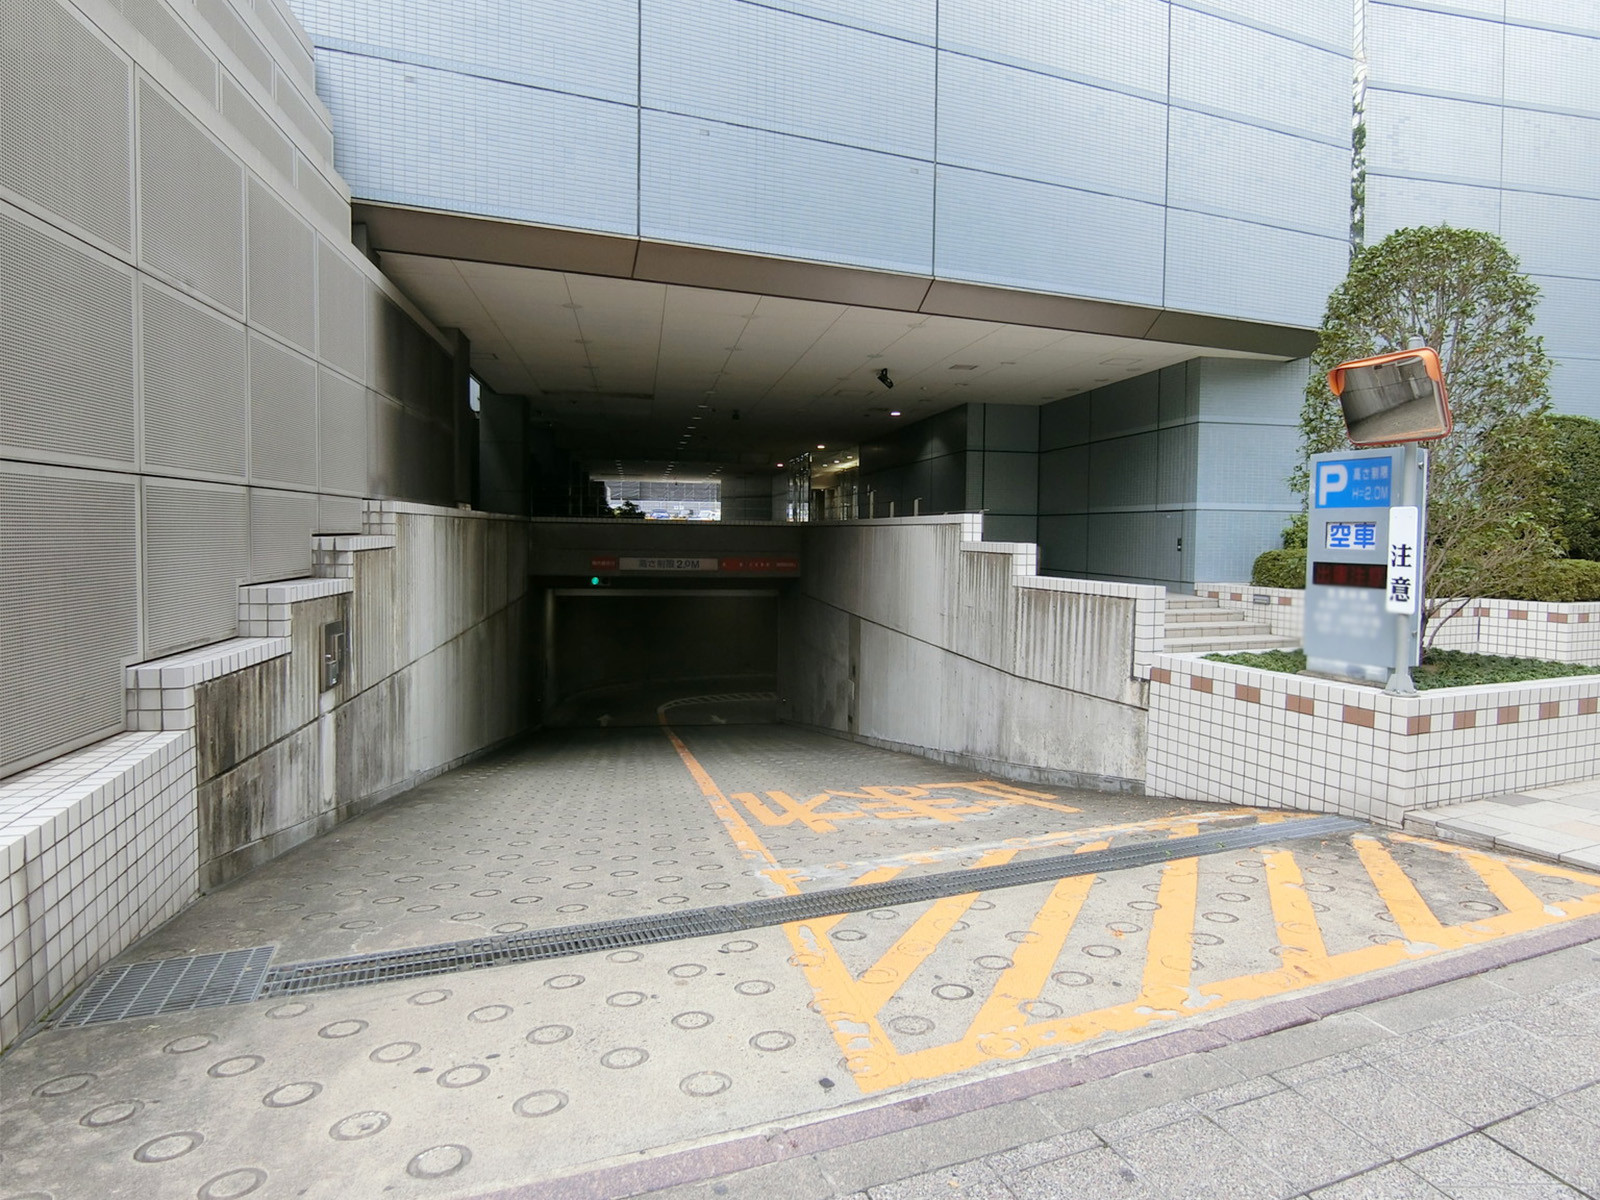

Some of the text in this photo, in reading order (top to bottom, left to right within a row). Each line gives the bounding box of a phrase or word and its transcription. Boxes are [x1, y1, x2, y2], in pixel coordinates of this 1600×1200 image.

[1319, 464, 1348, 506] P
[1353, 465, 1389, 481] 高さ制限
[1352, 486, 1389, 501] H=2.0M
[1329, 522, 1376, 549] 空車
[1389, 544, 1413, 603] 注意
[729, 778, 1085, 834] 止まれ
